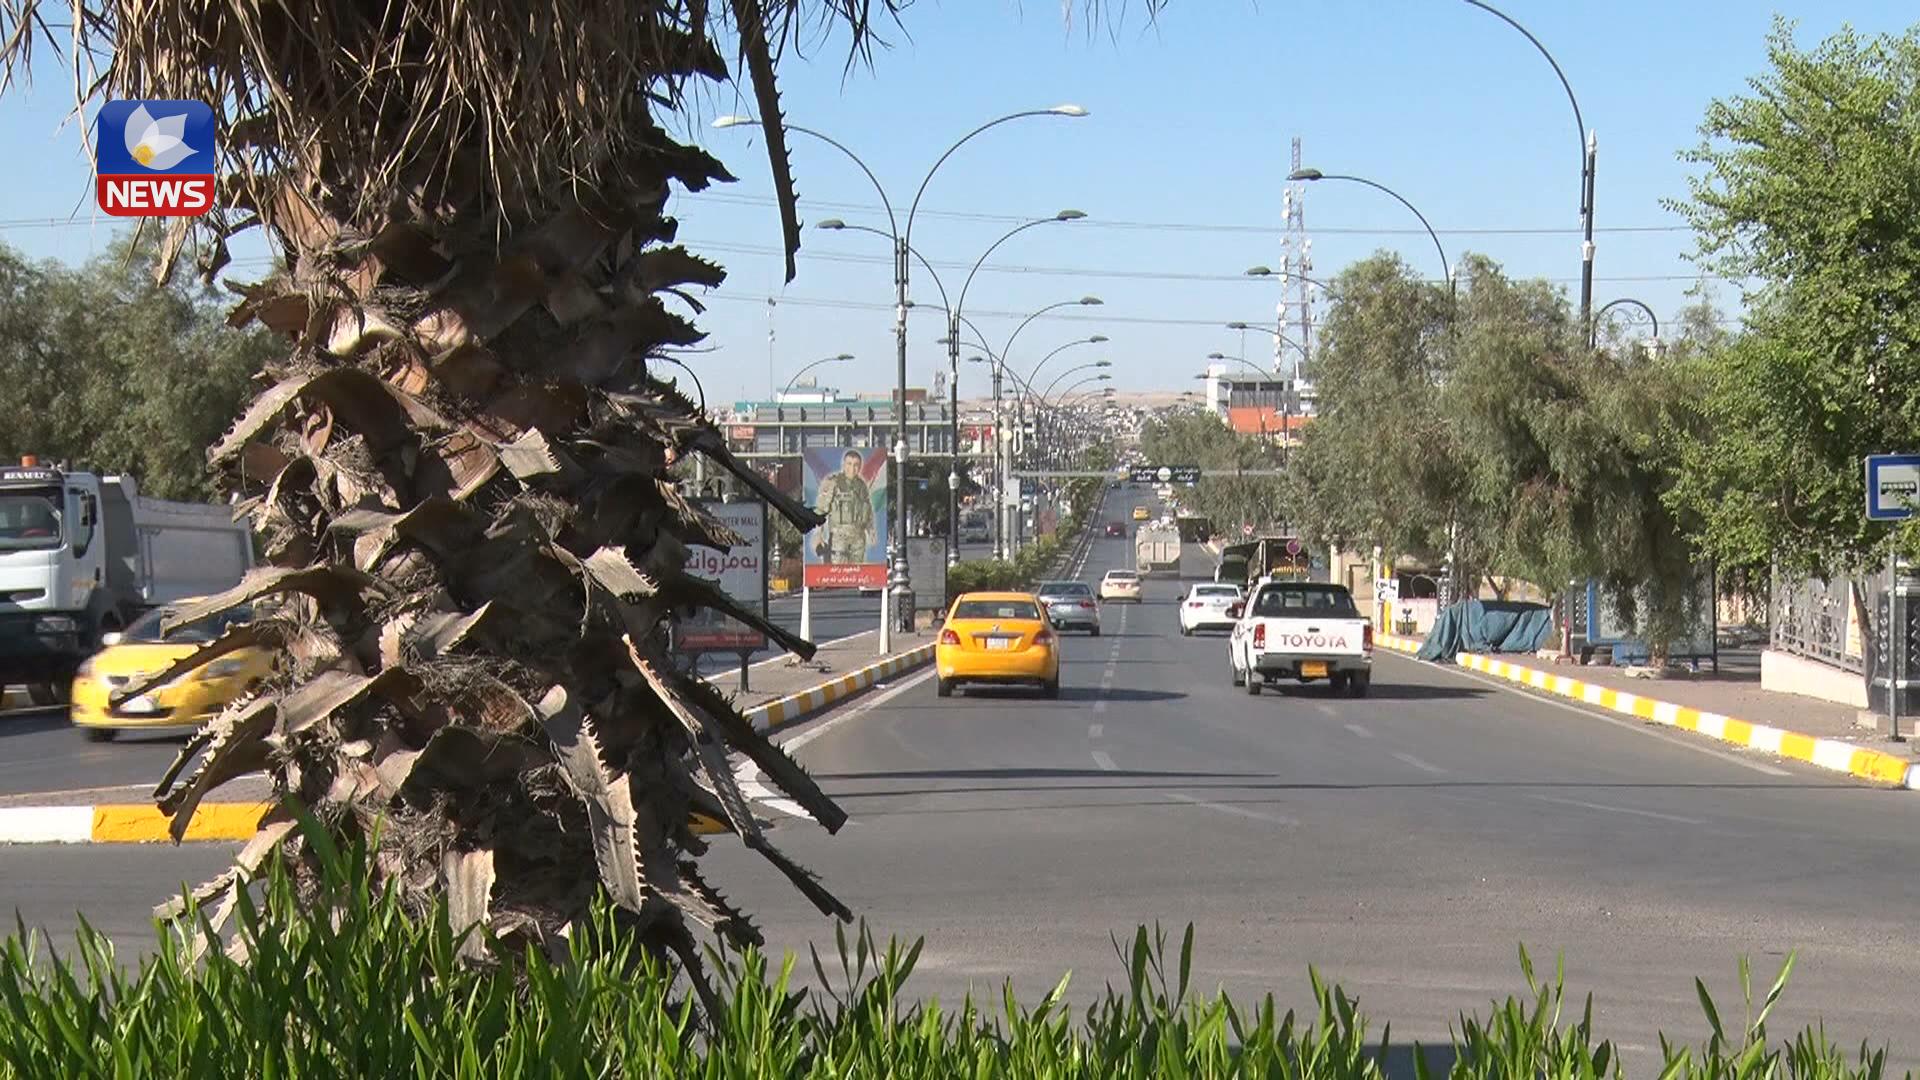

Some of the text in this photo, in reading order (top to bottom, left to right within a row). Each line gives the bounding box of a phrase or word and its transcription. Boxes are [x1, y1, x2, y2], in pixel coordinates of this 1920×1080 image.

[4, 471, 45, 480] RENAULT
[740, 516, 758, 526] MALL
[1281, 634, 1348, 649] TOYOTA
